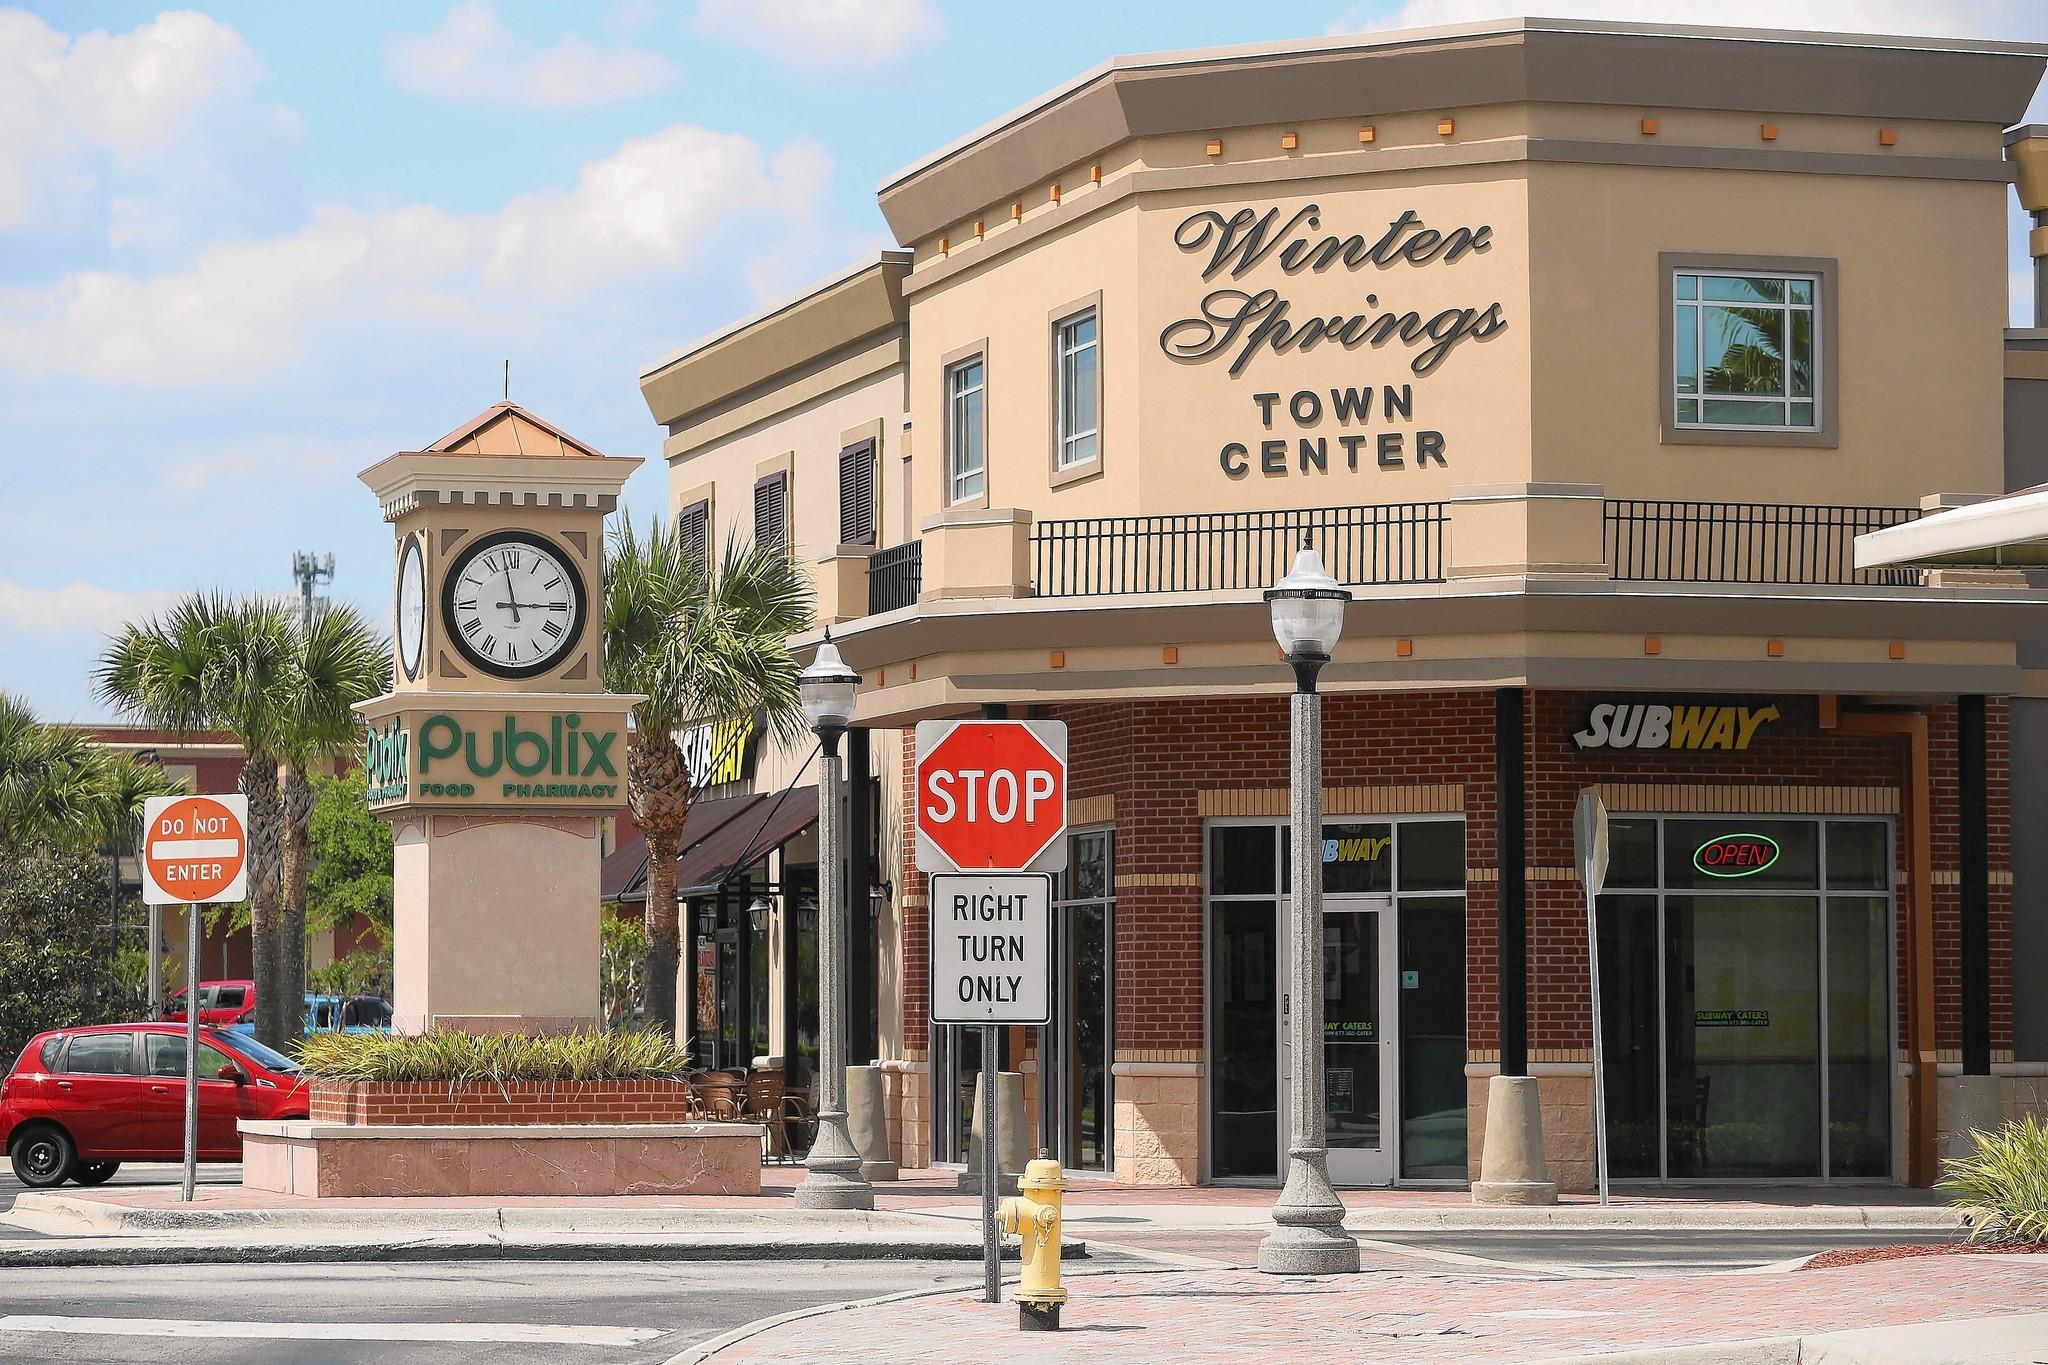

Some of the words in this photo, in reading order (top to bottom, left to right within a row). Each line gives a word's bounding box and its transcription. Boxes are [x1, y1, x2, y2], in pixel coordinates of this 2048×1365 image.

[1173, 203, 1493, 283] Winter
[1159, 288, 1508, 379] Springs
[1253, 383, 1413, 430] TOWN
[1219, 430, 1448, 480] CENTER
[366, 715, 408, 784] Publix
[418, 713, 618, 778] Publix
[1572, 703, 1781, 750] SUBWAY
[682, 714, 754, 789] SUBWAY
[419, 783, 475, 797] FOOD
[503, 783, 618, 798] PHARMACY
[926, 768, 1055, 824] STOP
[161, 819, 184, 835] DO
[195, 817, 228, 834] NOT
[1321, 836, 1392, 862] BWAY
[166, 863, 222, 881] ENTER
[1704, 844, 1769, 866] OPEN
[953, 894, 1027, 922] RIGHT
[958, 935, 1024, 962] TURN
[958, 975, 1022, 1003] ONLY
